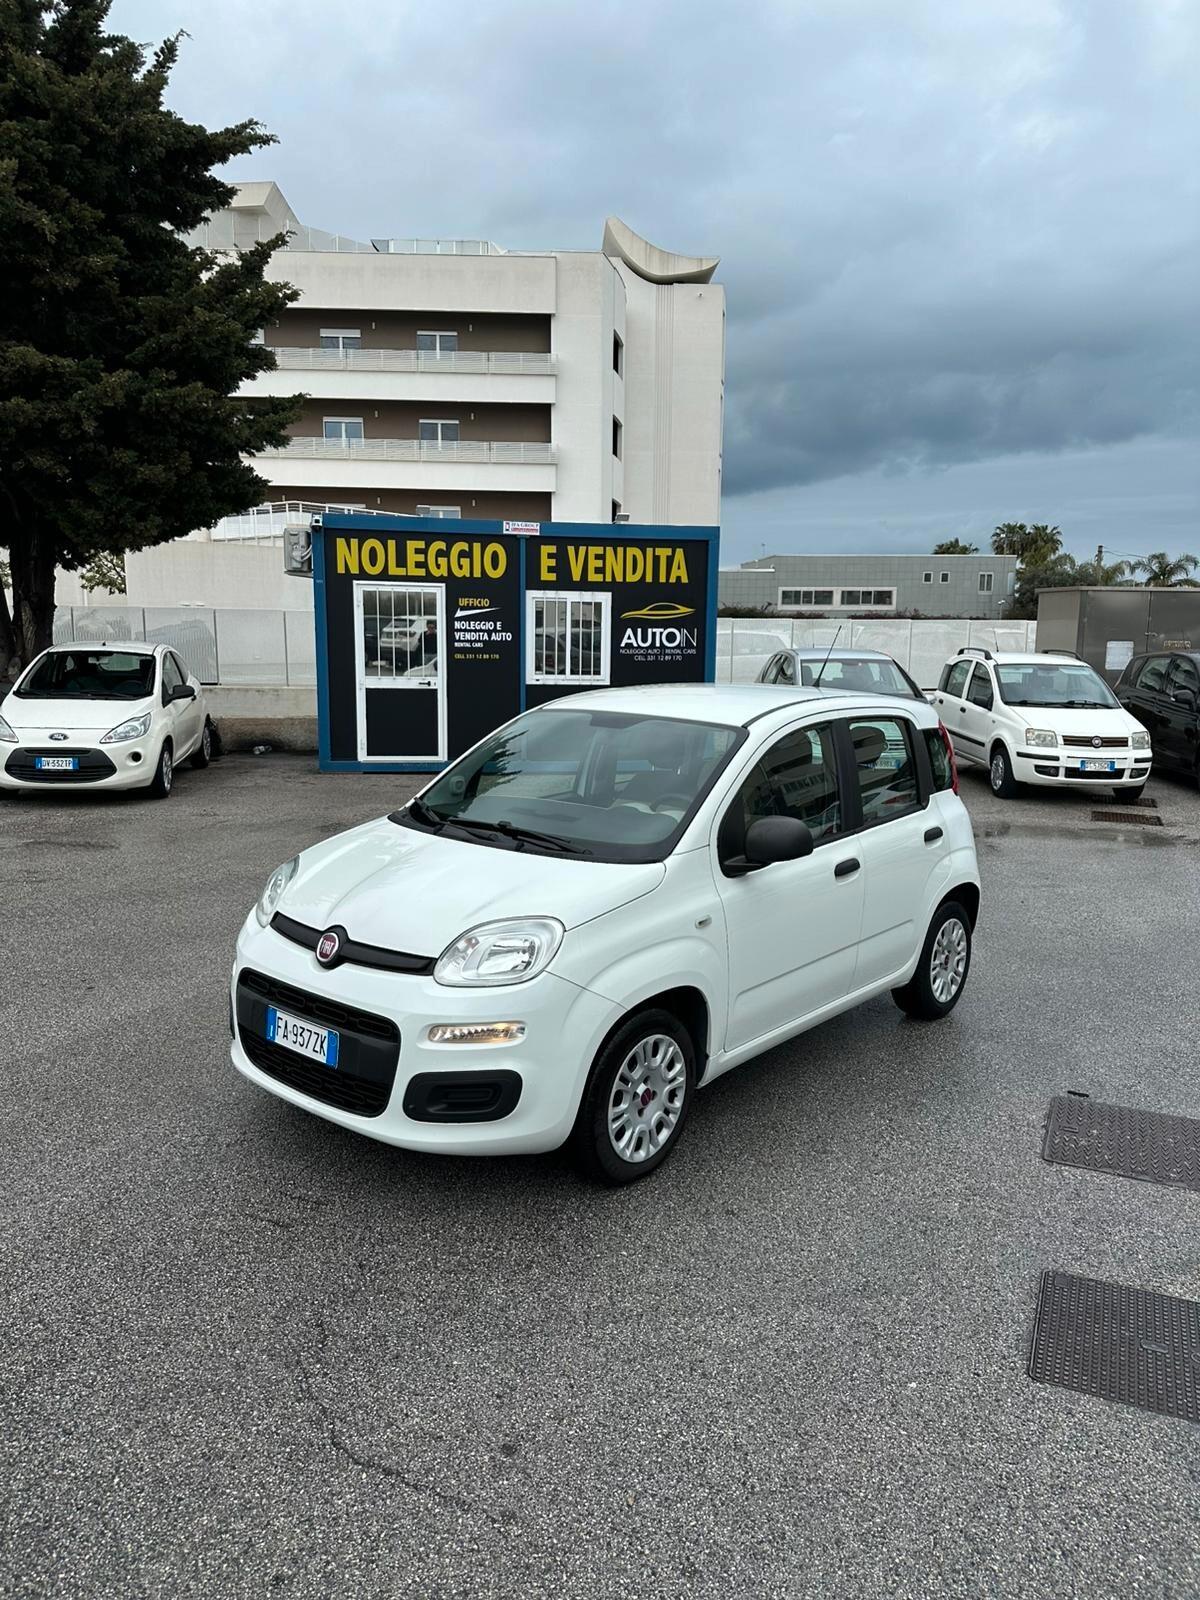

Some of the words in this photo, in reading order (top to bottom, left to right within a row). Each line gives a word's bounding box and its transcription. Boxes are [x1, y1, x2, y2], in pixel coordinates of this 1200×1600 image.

[336, 537, 507, 579] NOLEGGIO
[540, 545, 557, 581] E
[567, 545, 689, 583] VENDITA
[458, 598, 490, 607] UFFICIO
[454, 620, 495, 630] NOLEGGIO
[496, 621, 503, 630] E
[454, 631, 489, 641] VENDITA
[490, 632, 513, 641] AUTO
[620, 627, 697, 648] AUTOIN
[320, 939, 335, 955] FIAT
